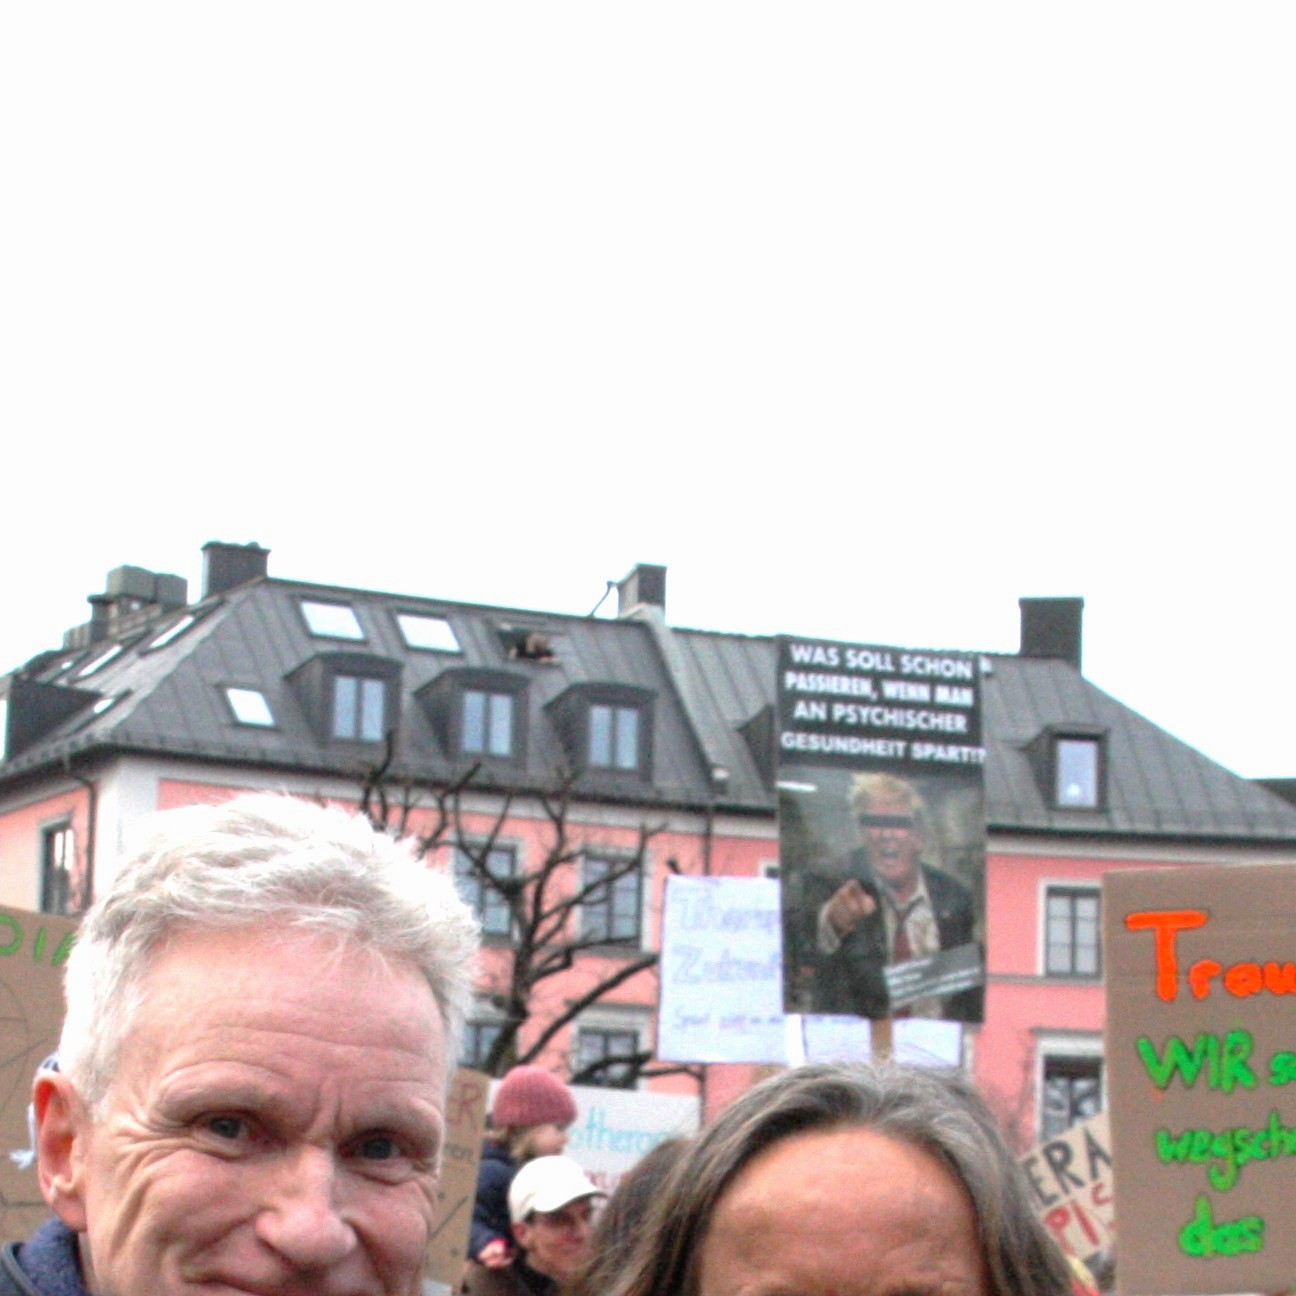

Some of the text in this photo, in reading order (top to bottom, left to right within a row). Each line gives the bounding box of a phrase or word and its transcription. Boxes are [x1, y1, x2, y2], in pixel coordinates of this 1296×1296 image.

[789, 643, 973, 680] WAS SOLL SCHON
[783, 671, 974, 707] PASSIEREN, WENN MAN
[793, 700, 968, 733] AN PSYCHISCHER
[780, 732, 908, 757] GESUNDHEIT
[1135, 1026, 1257, 1095] WIR
[1177, 1195, 1265, 1257] das
